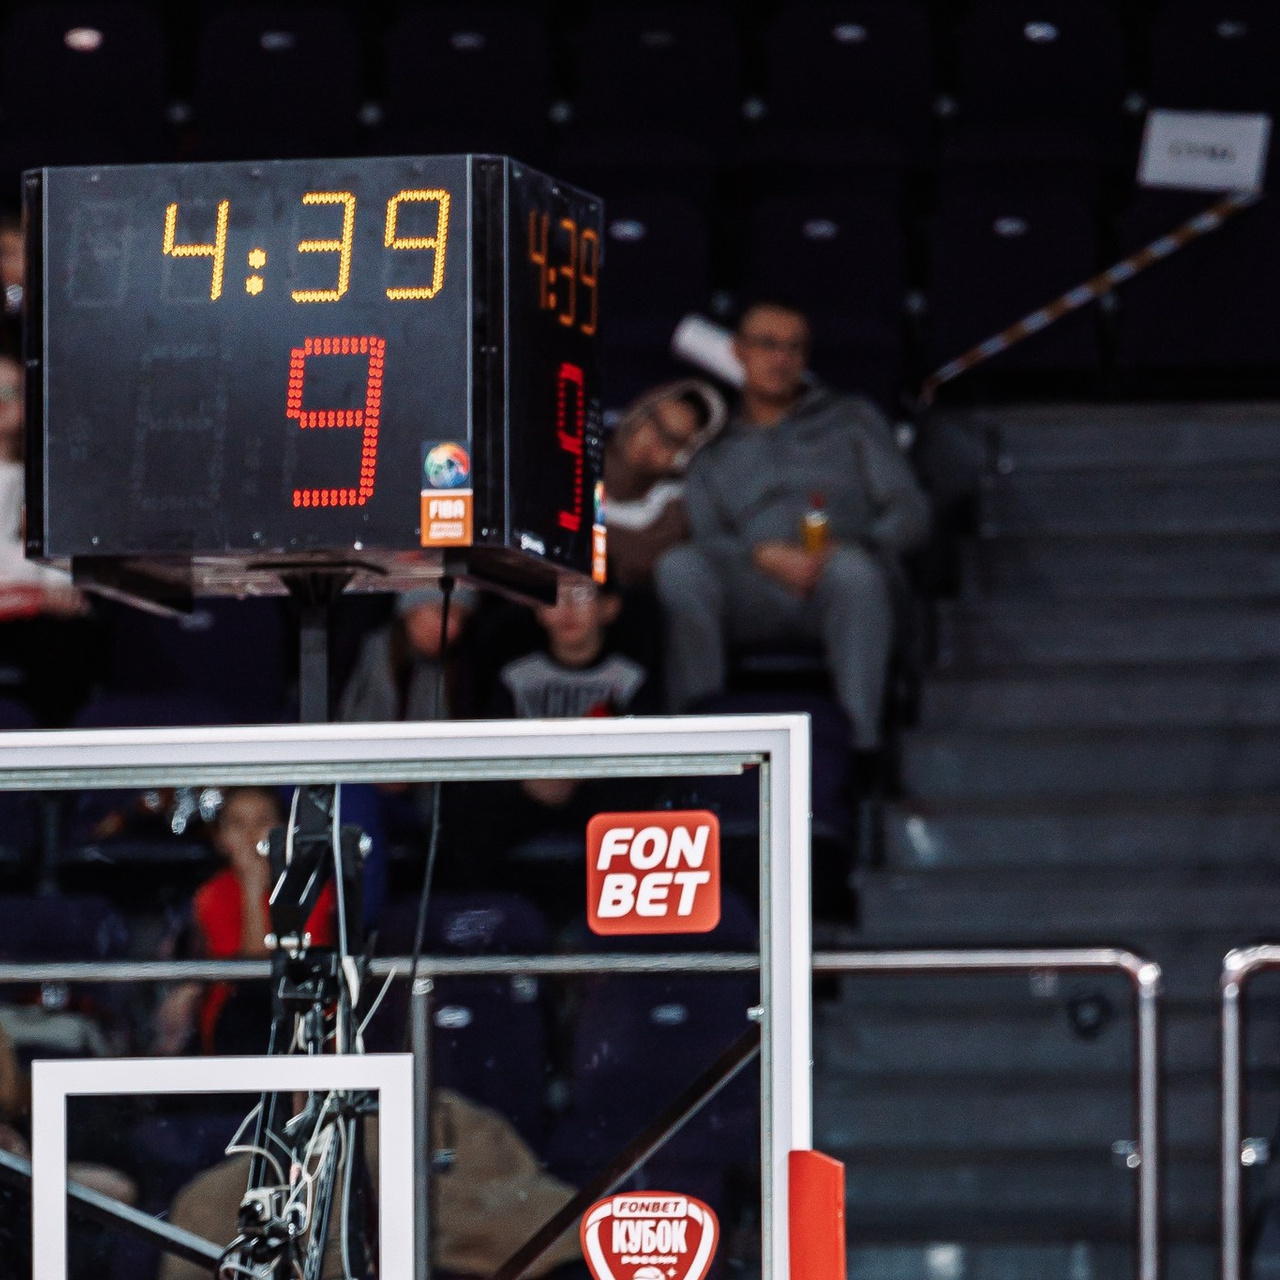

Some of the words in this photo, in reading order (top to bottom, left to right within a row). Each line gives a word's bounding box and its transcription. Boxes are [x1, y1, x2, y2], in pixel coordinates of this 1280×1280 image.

[163, 188, 451, 303] 4:39
[286, 335, 386, 507] 9
[557, 361, 584, 532] 9
[596, 825, 711, 871] FON
[596, 870, 711, 919] BET
[619, 1201, 682, 1213] FONBET
[611, 1219, 688, 1254] КУБОК
